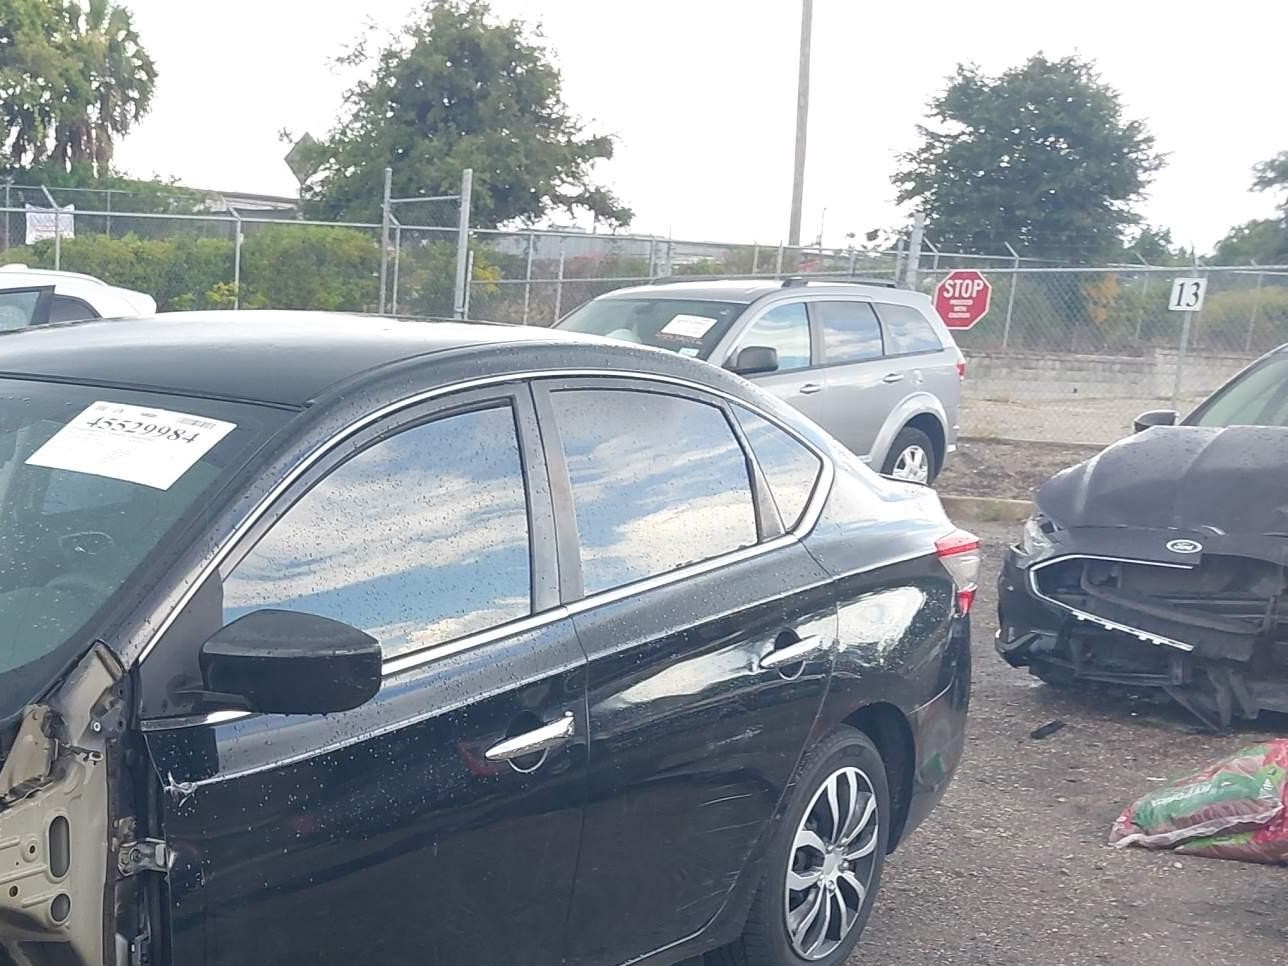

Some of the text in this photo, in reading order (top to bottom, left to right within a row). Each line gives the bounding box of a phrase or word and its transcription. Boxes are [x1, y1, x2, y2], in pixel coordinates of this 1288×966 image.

[943, 279, 984, 298] STOP
[1175, 281, 1201, 307] 13
[86, 416, 200, 444] 45529984
